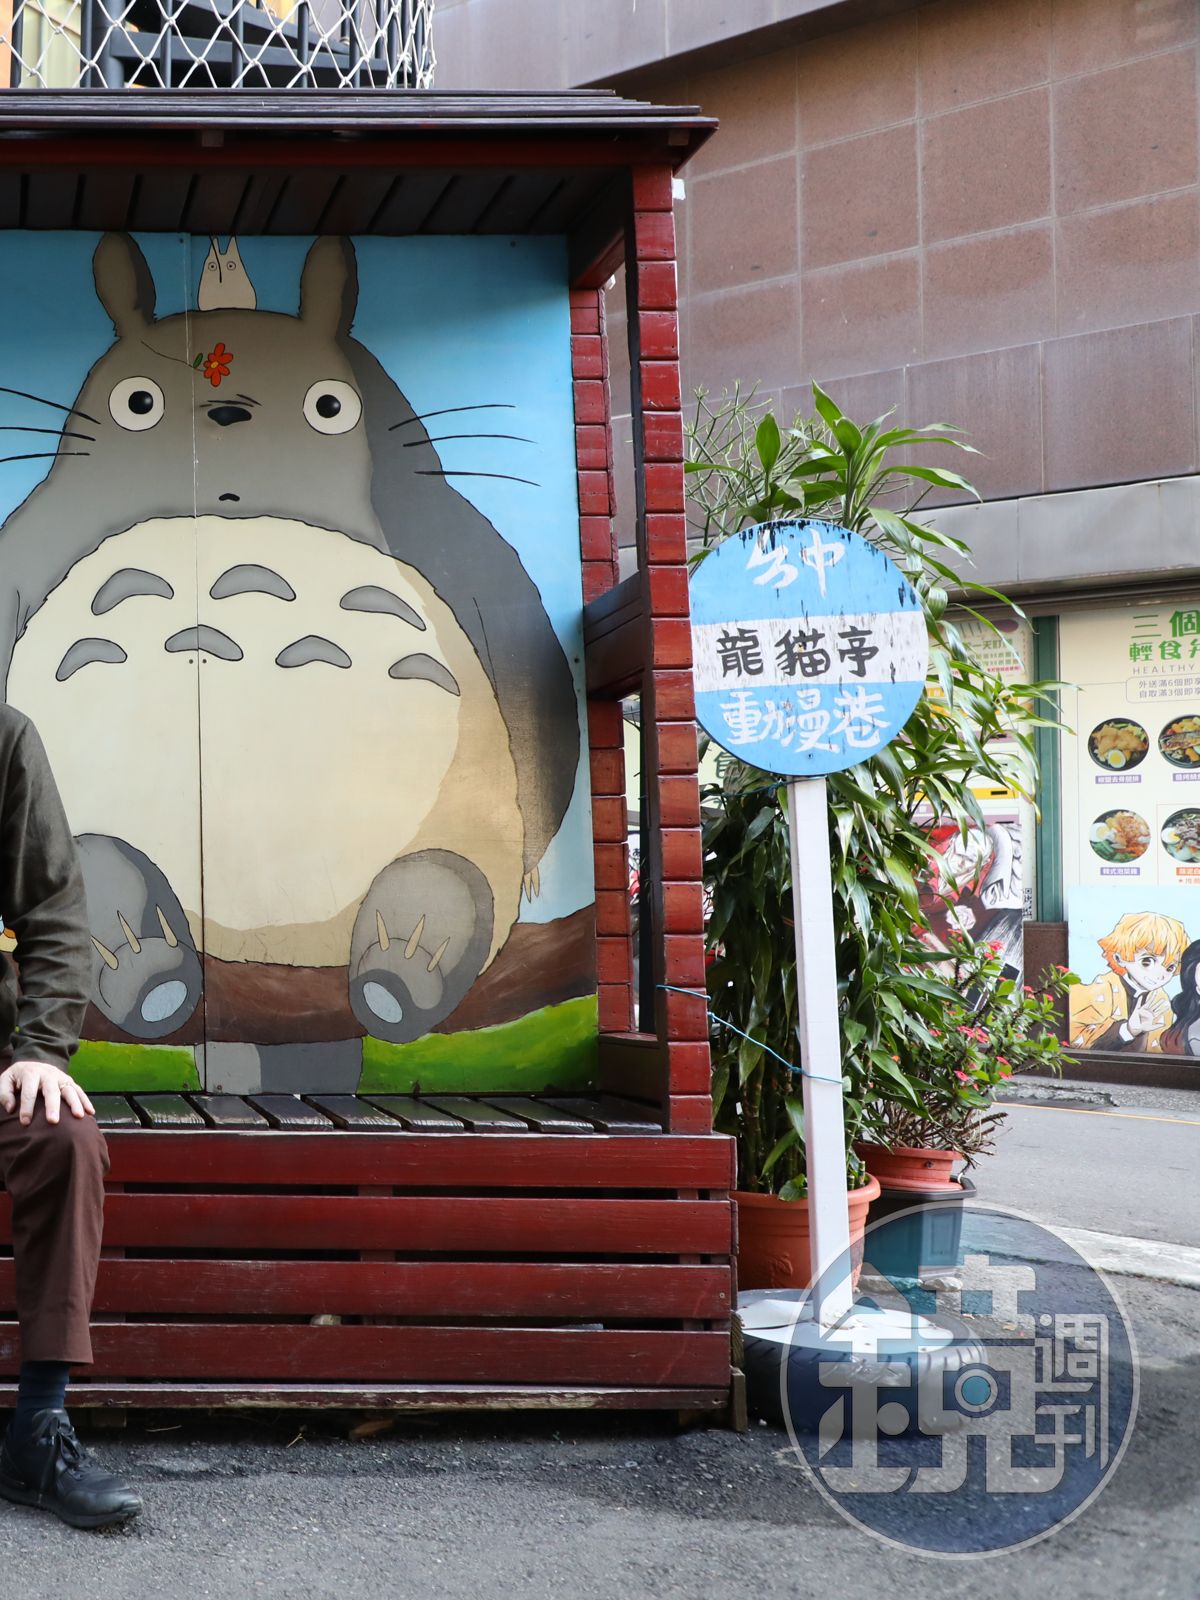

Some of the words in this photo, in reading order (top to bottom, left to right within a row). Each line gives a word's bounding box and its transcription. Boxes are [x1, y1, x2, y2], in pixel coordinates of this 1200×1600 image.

[715, 625, 880, 678] 龍貓亭
[1132, 663, 1195, 675] HEALTHY
[719, 685, 892, 754] 動漫巷
